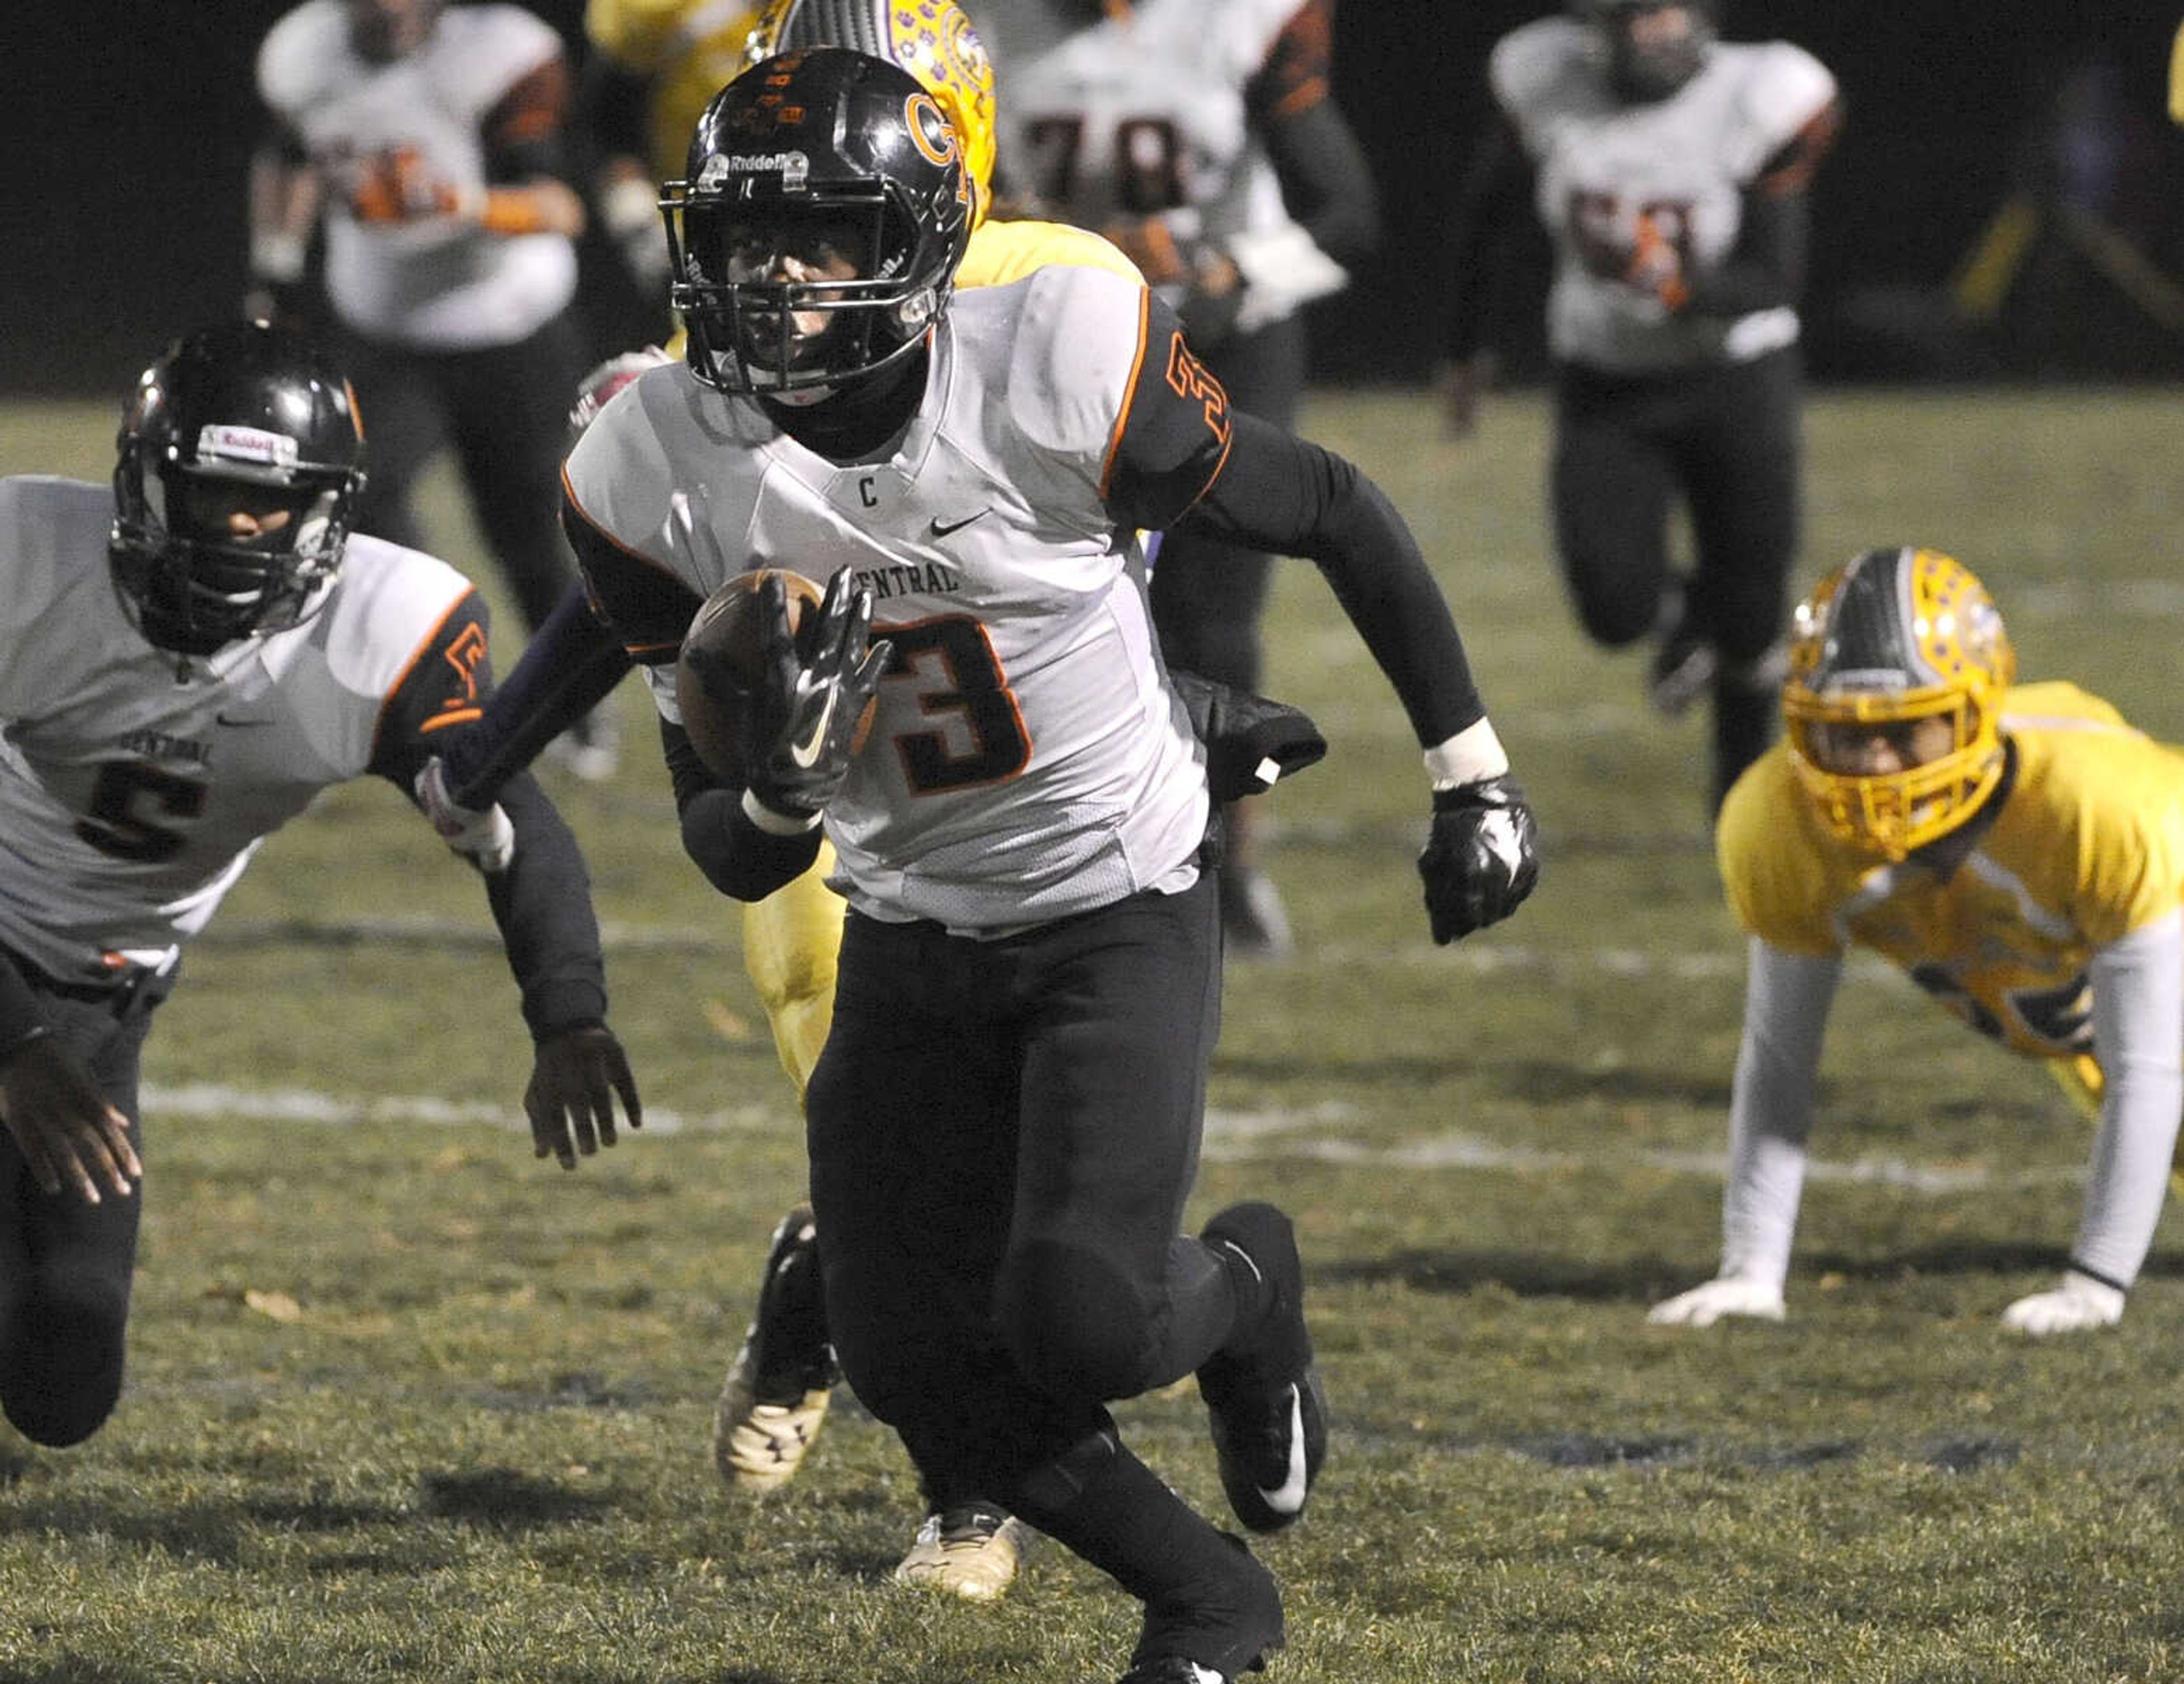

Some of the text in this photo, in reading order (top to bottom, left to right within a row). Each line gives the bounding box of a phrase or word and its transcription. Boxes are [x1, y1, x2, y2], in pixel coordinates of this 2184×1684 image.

[731, 152, 785, 171] Riddell
[1166, 331, 1232, 445] 3
[858, 478, 878, 508] C
[855, 562, 959, 598] ENTRAL
[872, 611, 1034, 798] 3
[75, 759, 208, 864] 5
